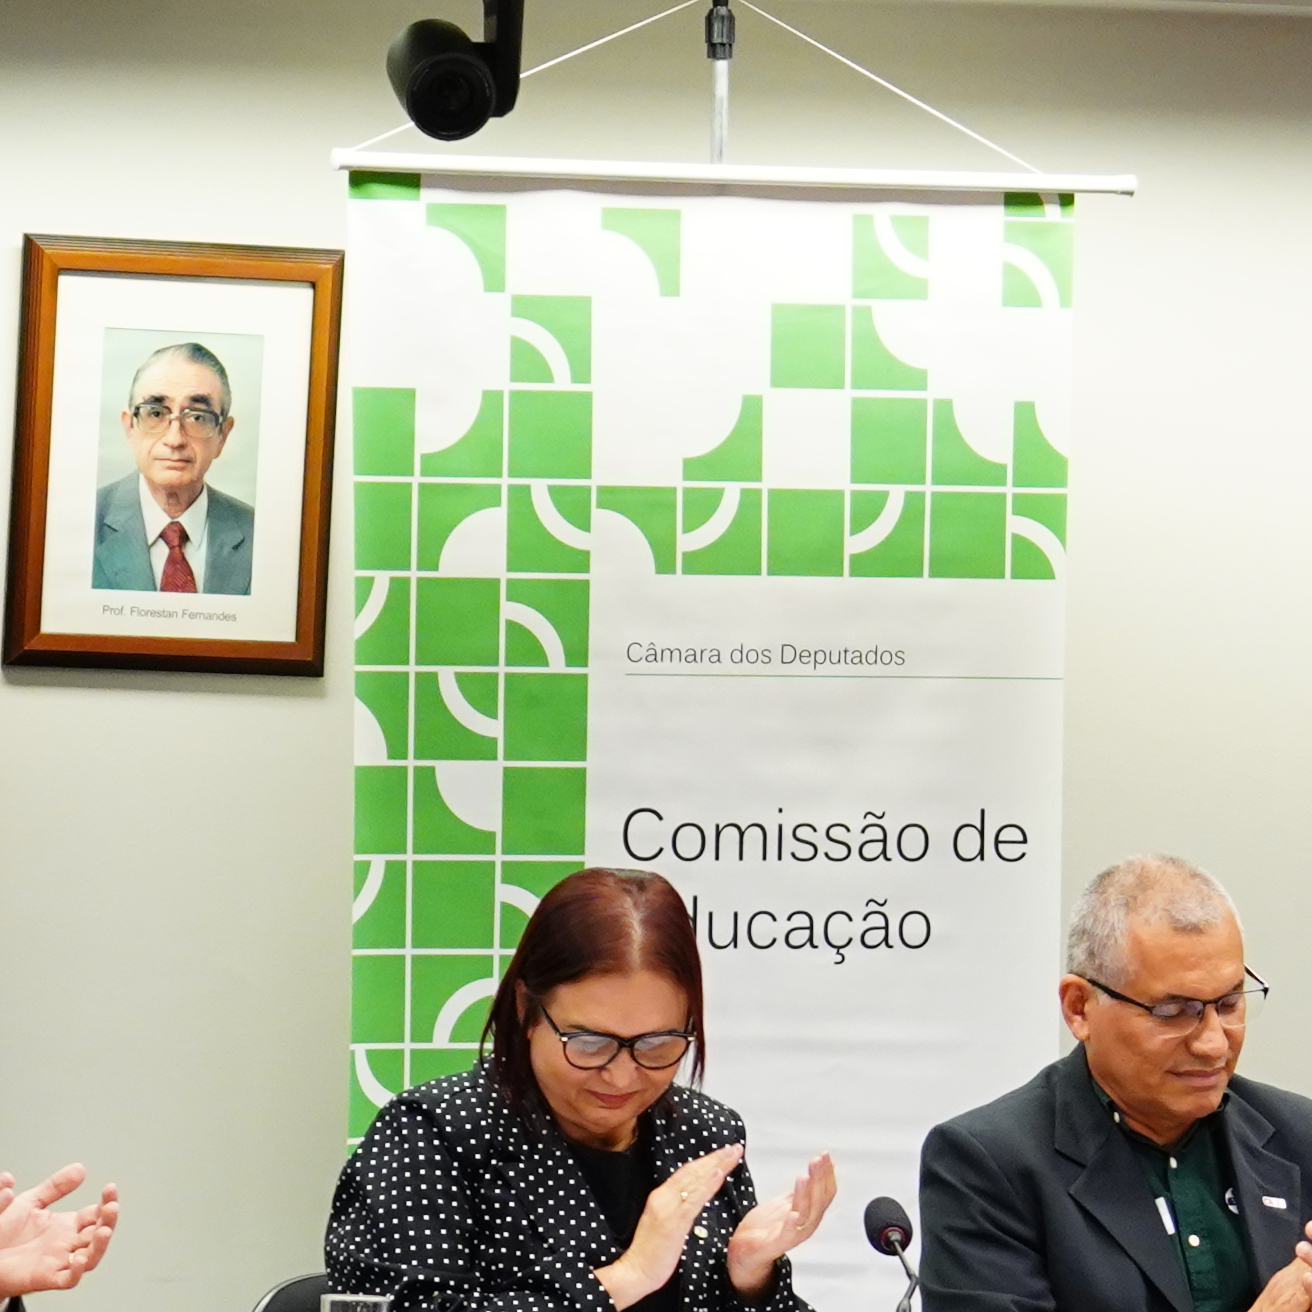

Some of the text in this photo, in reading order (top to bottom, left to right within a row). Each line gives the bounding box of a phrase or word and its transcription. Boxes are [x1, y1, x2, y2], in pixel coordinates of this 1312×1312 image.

[101, 604, 238, 623] Prof. Florestan Fernandes
[626, 641, 906, 671] Câmara dos Deputados
[622, 807, 1029, 863] Comissão de
[688, 894, 931, 965] ucação
